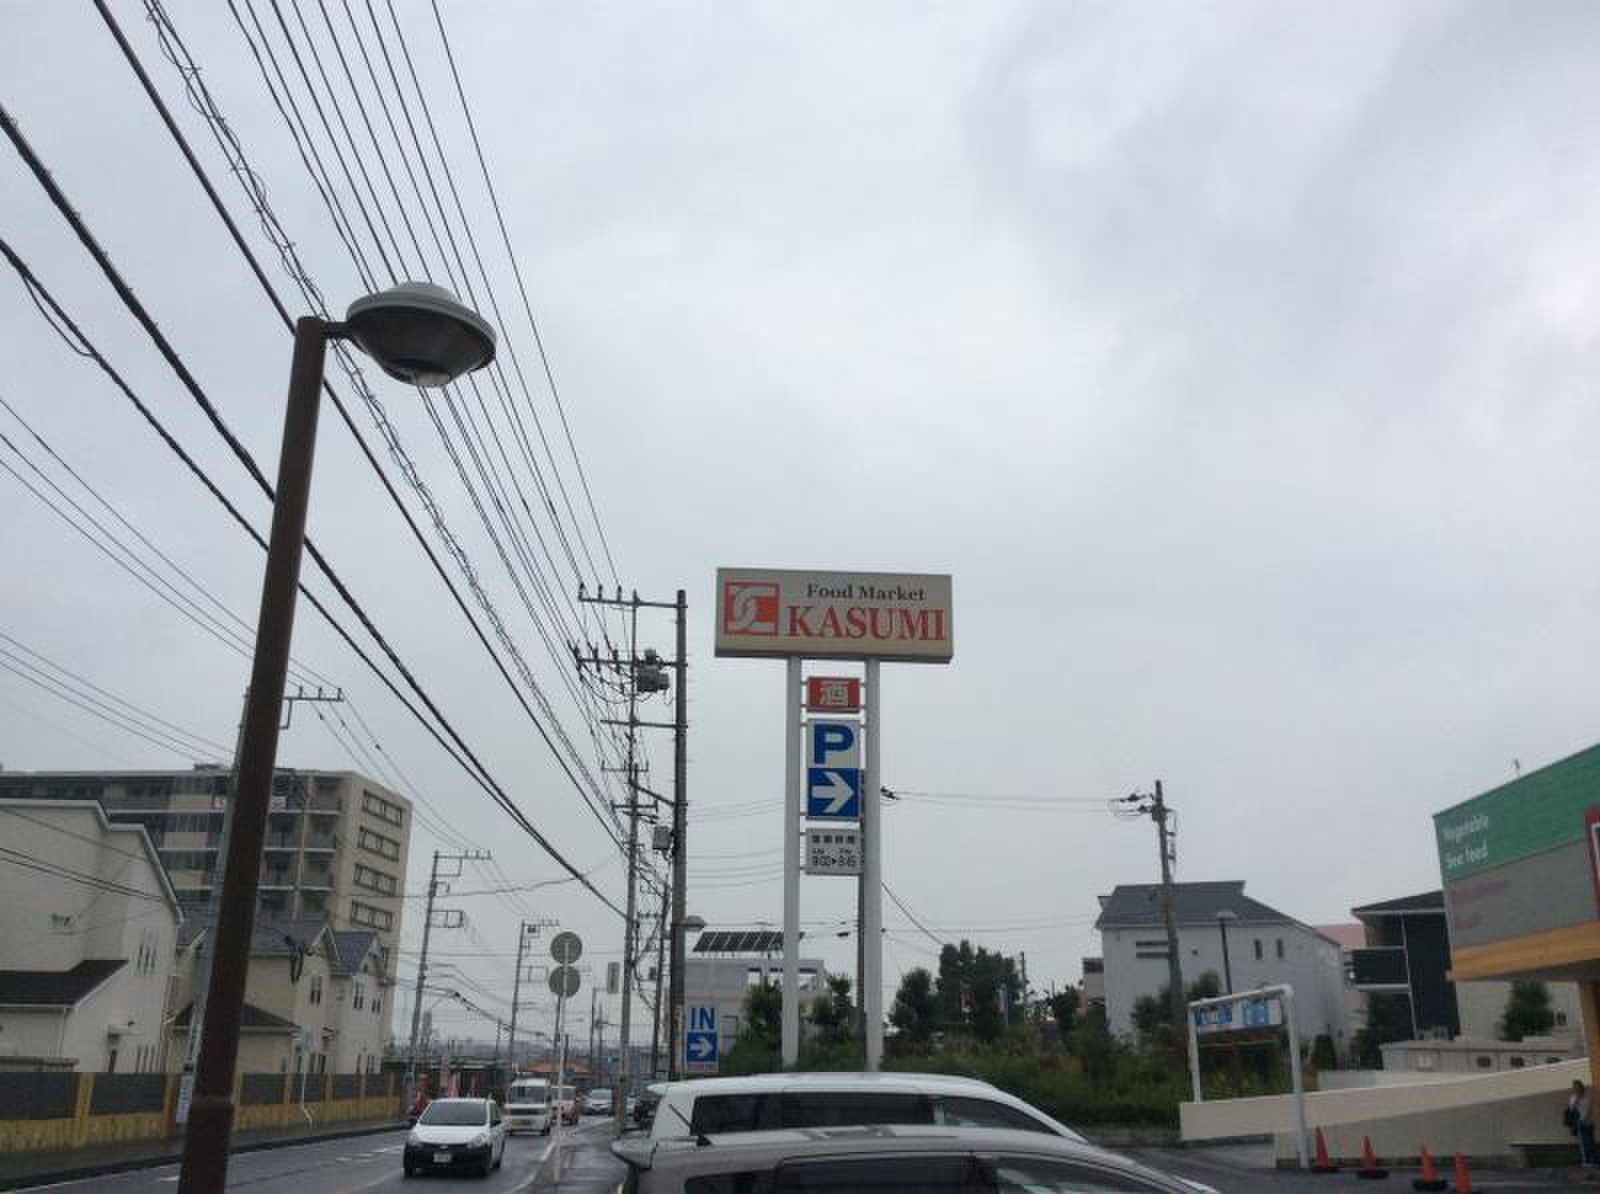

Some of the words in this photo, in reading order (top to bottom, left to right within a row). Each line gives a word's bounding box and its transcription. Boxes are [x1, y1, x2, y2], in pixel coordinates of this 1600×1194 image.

[807, 583, 852, 598] Food
[859, 586, 925, 601] Market
[787, 605, 945, 641] KASUMI
[814, 724, 854, 764] P
[691, 1007, 715, 1029] IN
